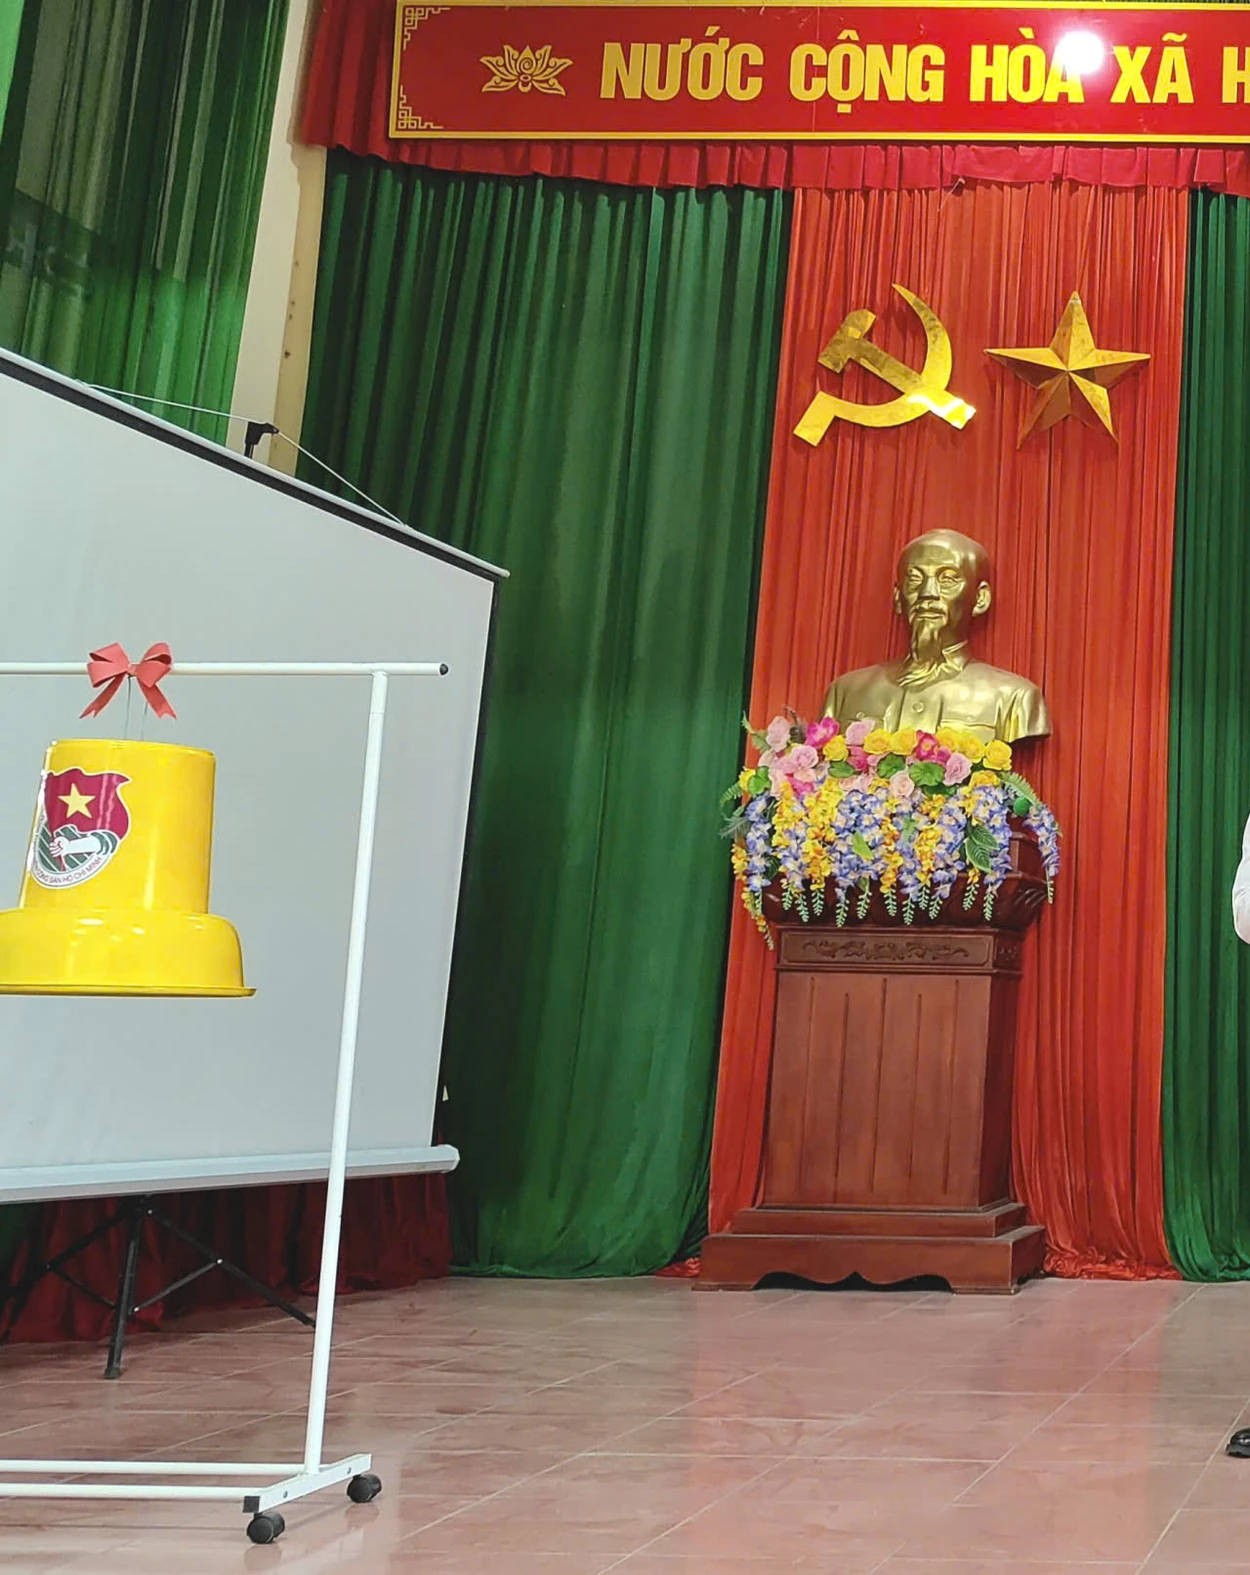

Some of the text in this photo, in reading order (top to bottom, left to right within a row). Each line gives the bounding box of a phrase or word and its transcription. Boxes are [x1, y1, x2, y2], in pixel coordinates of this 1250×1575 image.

[600, 26, 764, 101] NƯỚC
[789, 29, 946, 113] CỘNG
[969, 27, 1085, 103] HÒA
[1110, 32, 1194, 104] XÃ
